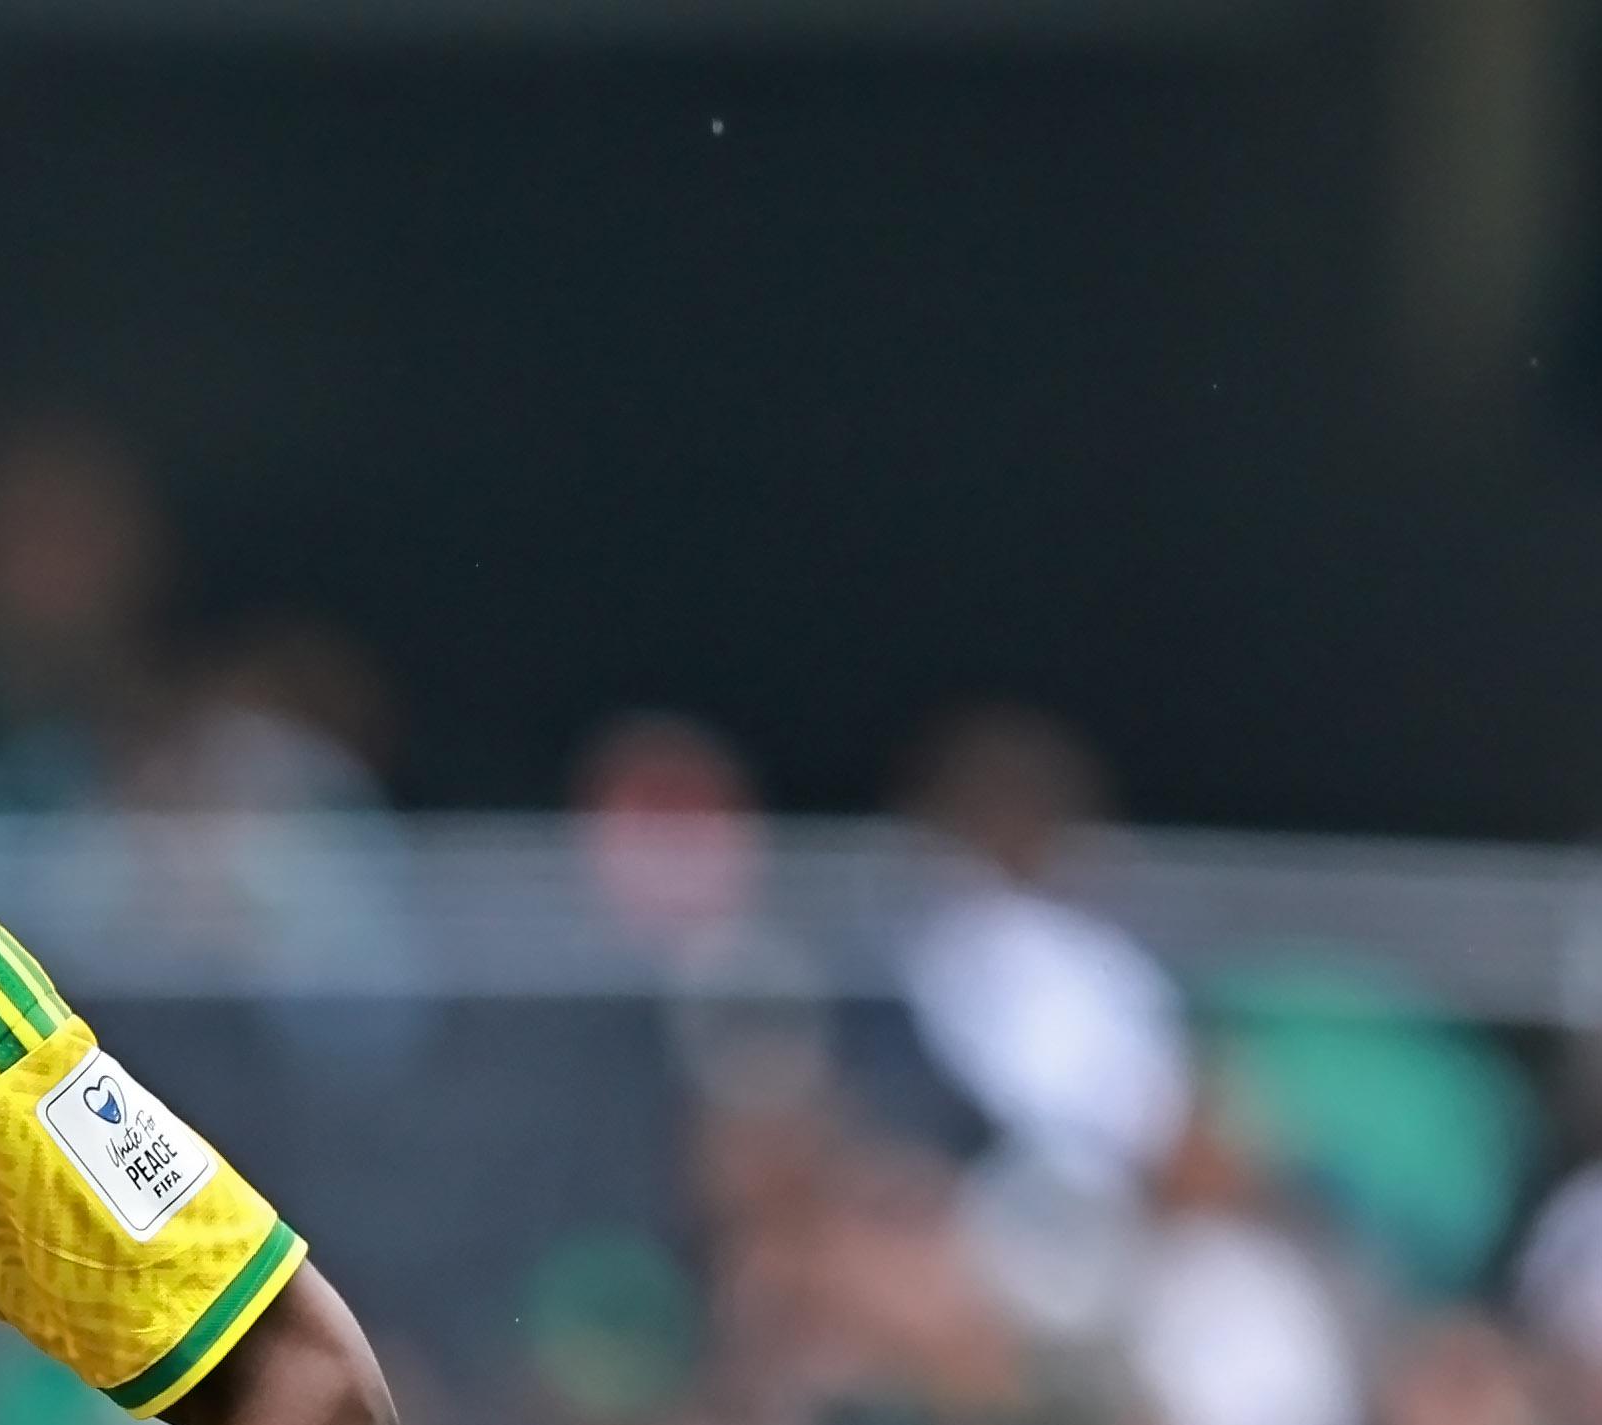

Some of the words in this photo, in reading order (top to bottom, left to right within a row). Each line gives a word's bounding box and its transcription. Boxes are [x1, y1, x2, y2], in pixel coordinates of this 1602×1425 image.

[106, 1127, 143, 1168] Unite
[125, 1134, 178, 1191] PEACE
[153, 1170, 182, 1198] FIFA
